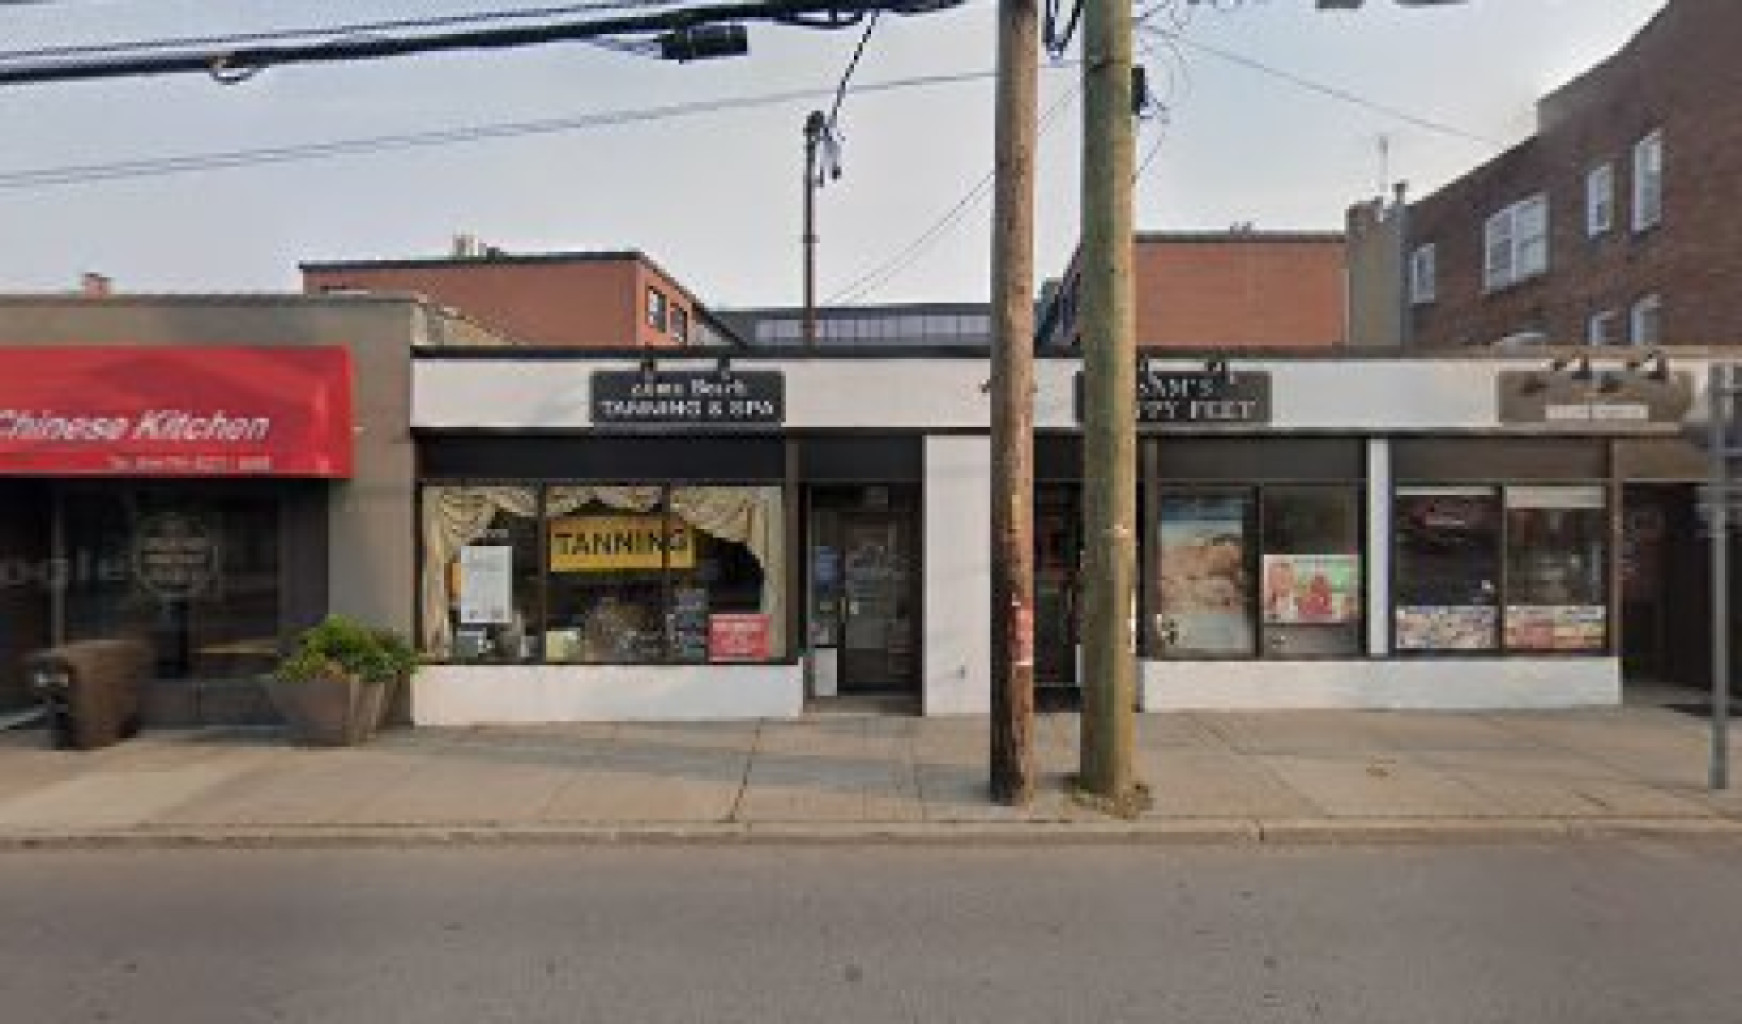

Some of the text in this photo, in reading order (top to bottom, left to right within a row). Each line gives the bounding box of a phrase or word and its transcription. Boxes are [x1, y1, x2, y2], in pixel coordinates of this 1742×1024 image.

[601, 400, 774, 417] TANNING & SPA
[131, 409, 270, 440] Kitchen
[553, 528, 693, 556] TANNING
